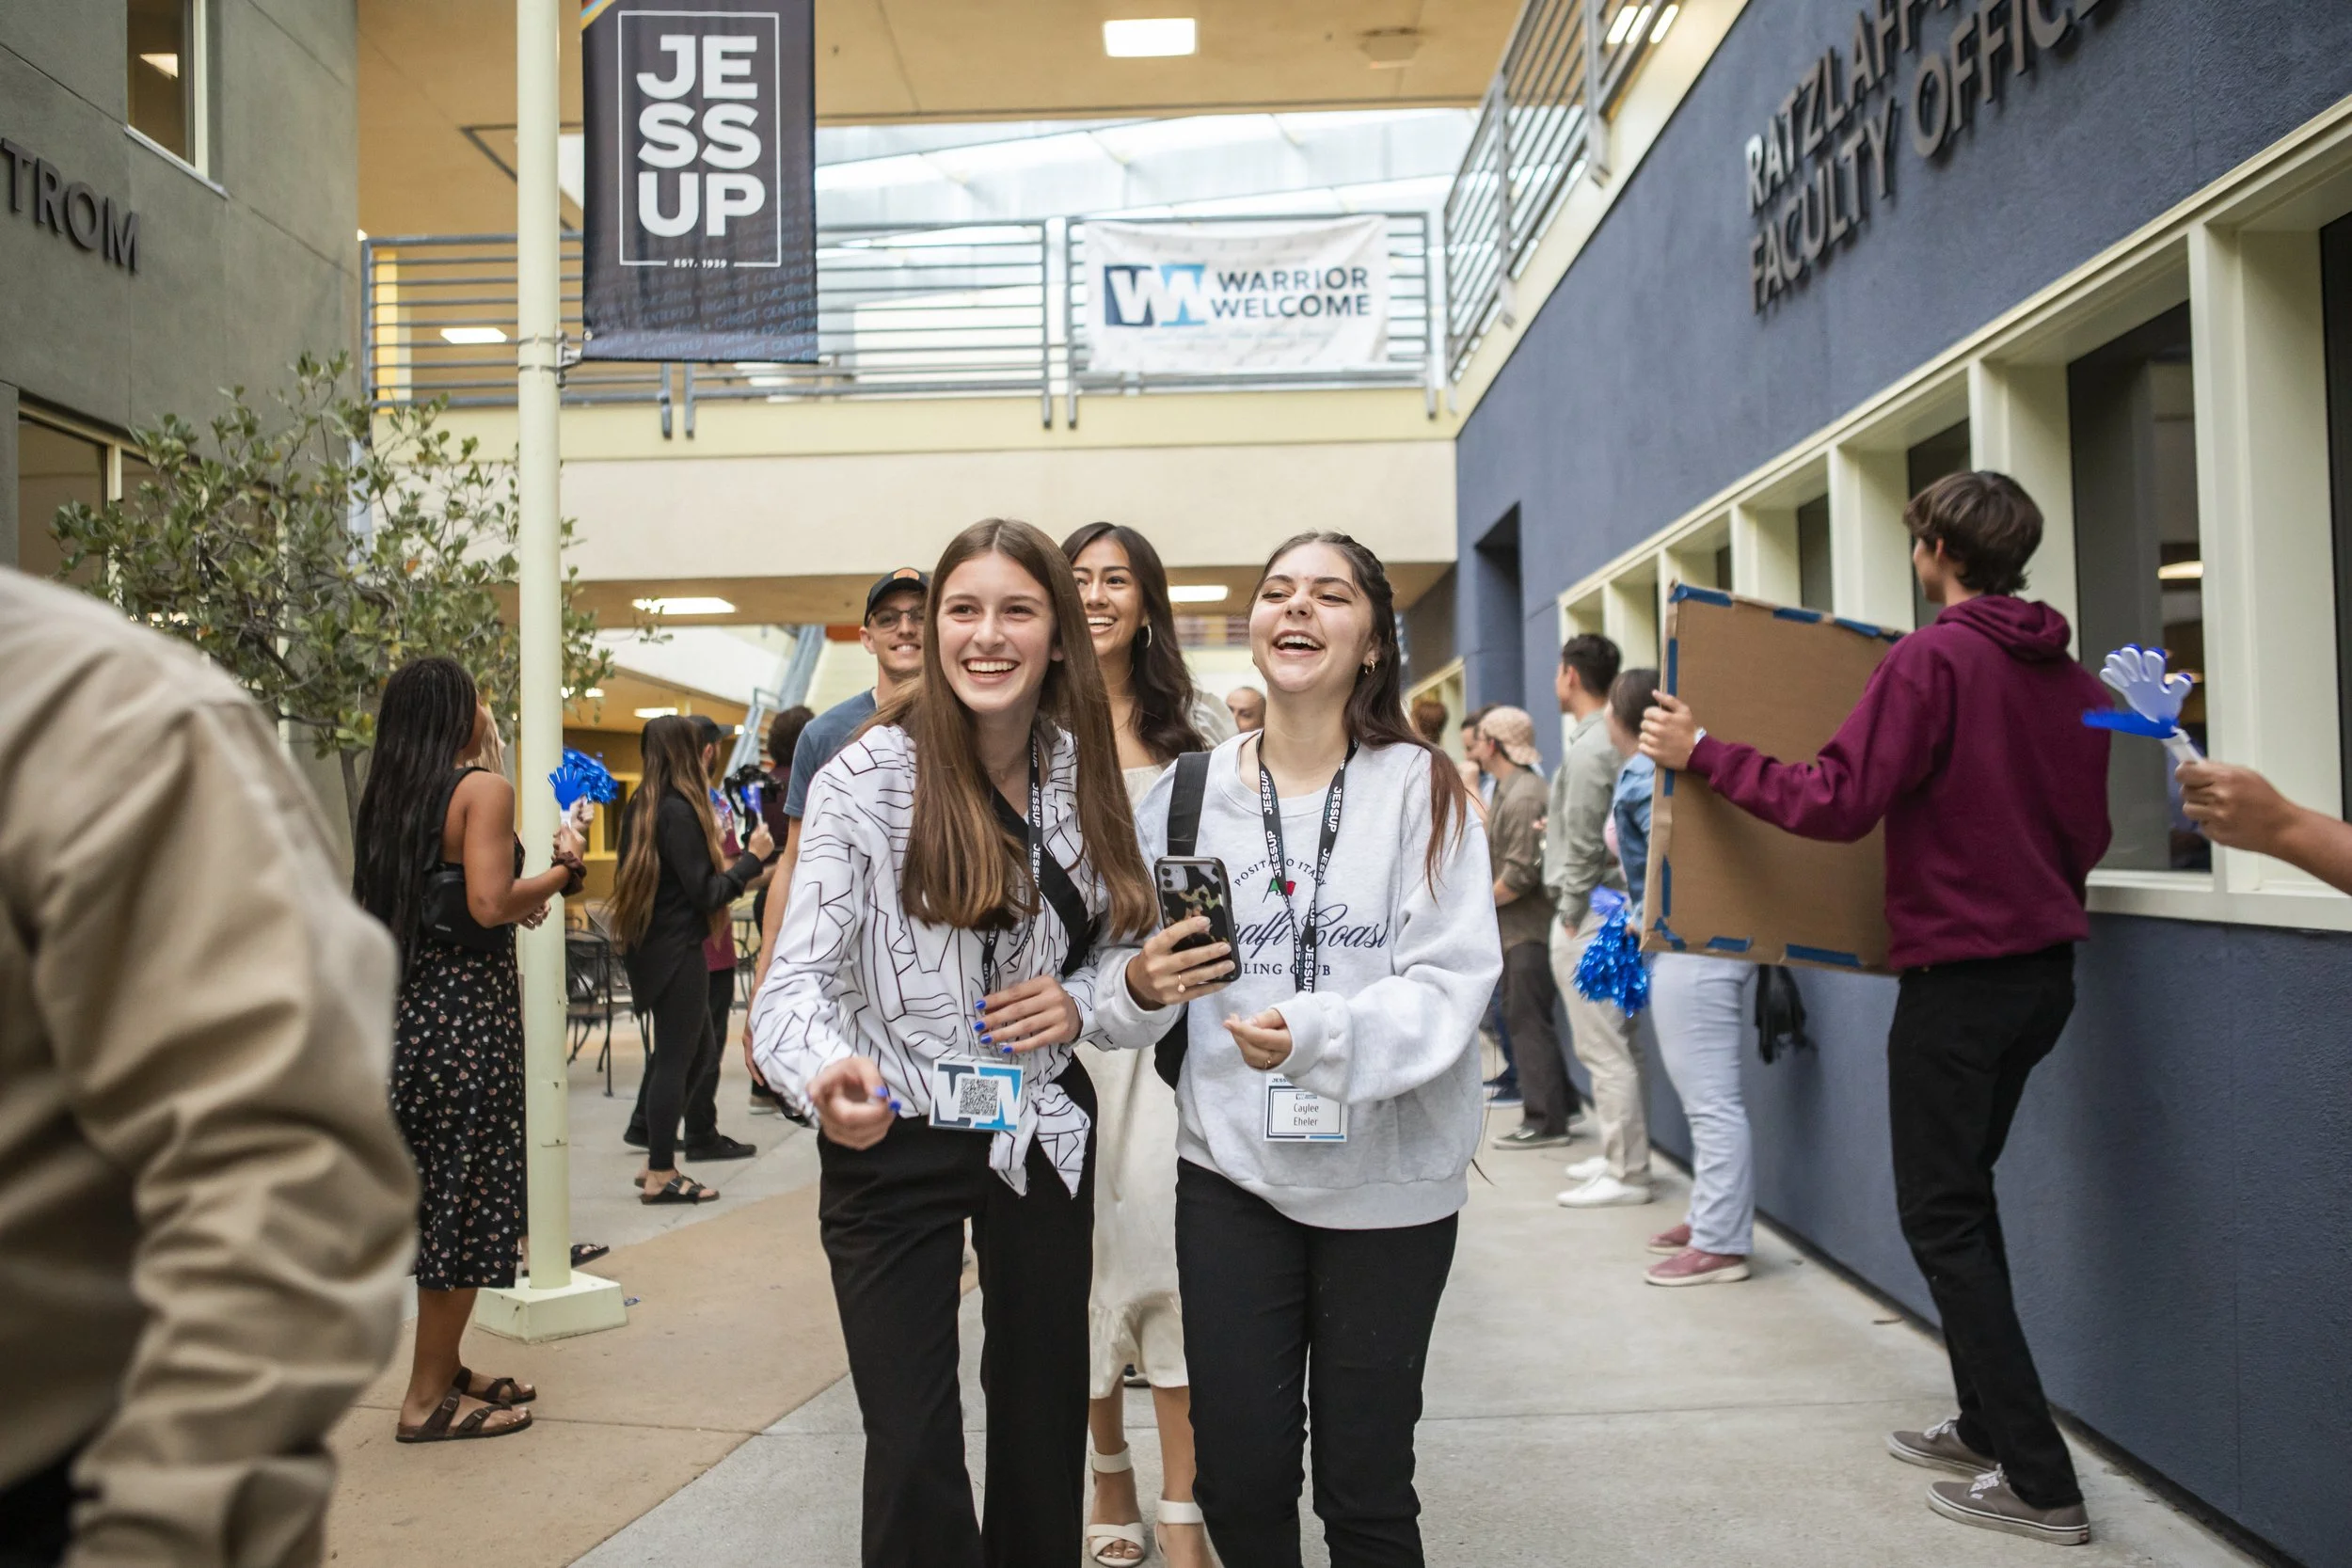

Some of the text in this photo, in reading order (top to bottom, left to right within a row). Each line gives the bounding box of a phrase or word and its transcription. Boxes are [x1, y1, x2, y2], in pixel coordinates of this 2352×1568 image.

[636, 34, 758, 101] JE
[637, 102, 763, 169] SS
[638, 171, 767, 238] UP
[1751, 96, 1895, 316] FACULTY
[1216, 266, 1369, 293] WARRIOR
[1211, 294, 1372, 318] WELCOME
[1032, 782, 1041, 828] JESSUP
[1261, 770, 1273, 816] JESSUP
[1327, 785, 1343, 832] JESSUP
[1234, 858, 1295, 887] POSITO
[1266, 831, 1281, 878] JESSUP
[1317, 847, 1330, 882] JESS
[1294, 1103, 1319, 1115] Caylee
[1294, 1117, 1318, 1127] Eheler
